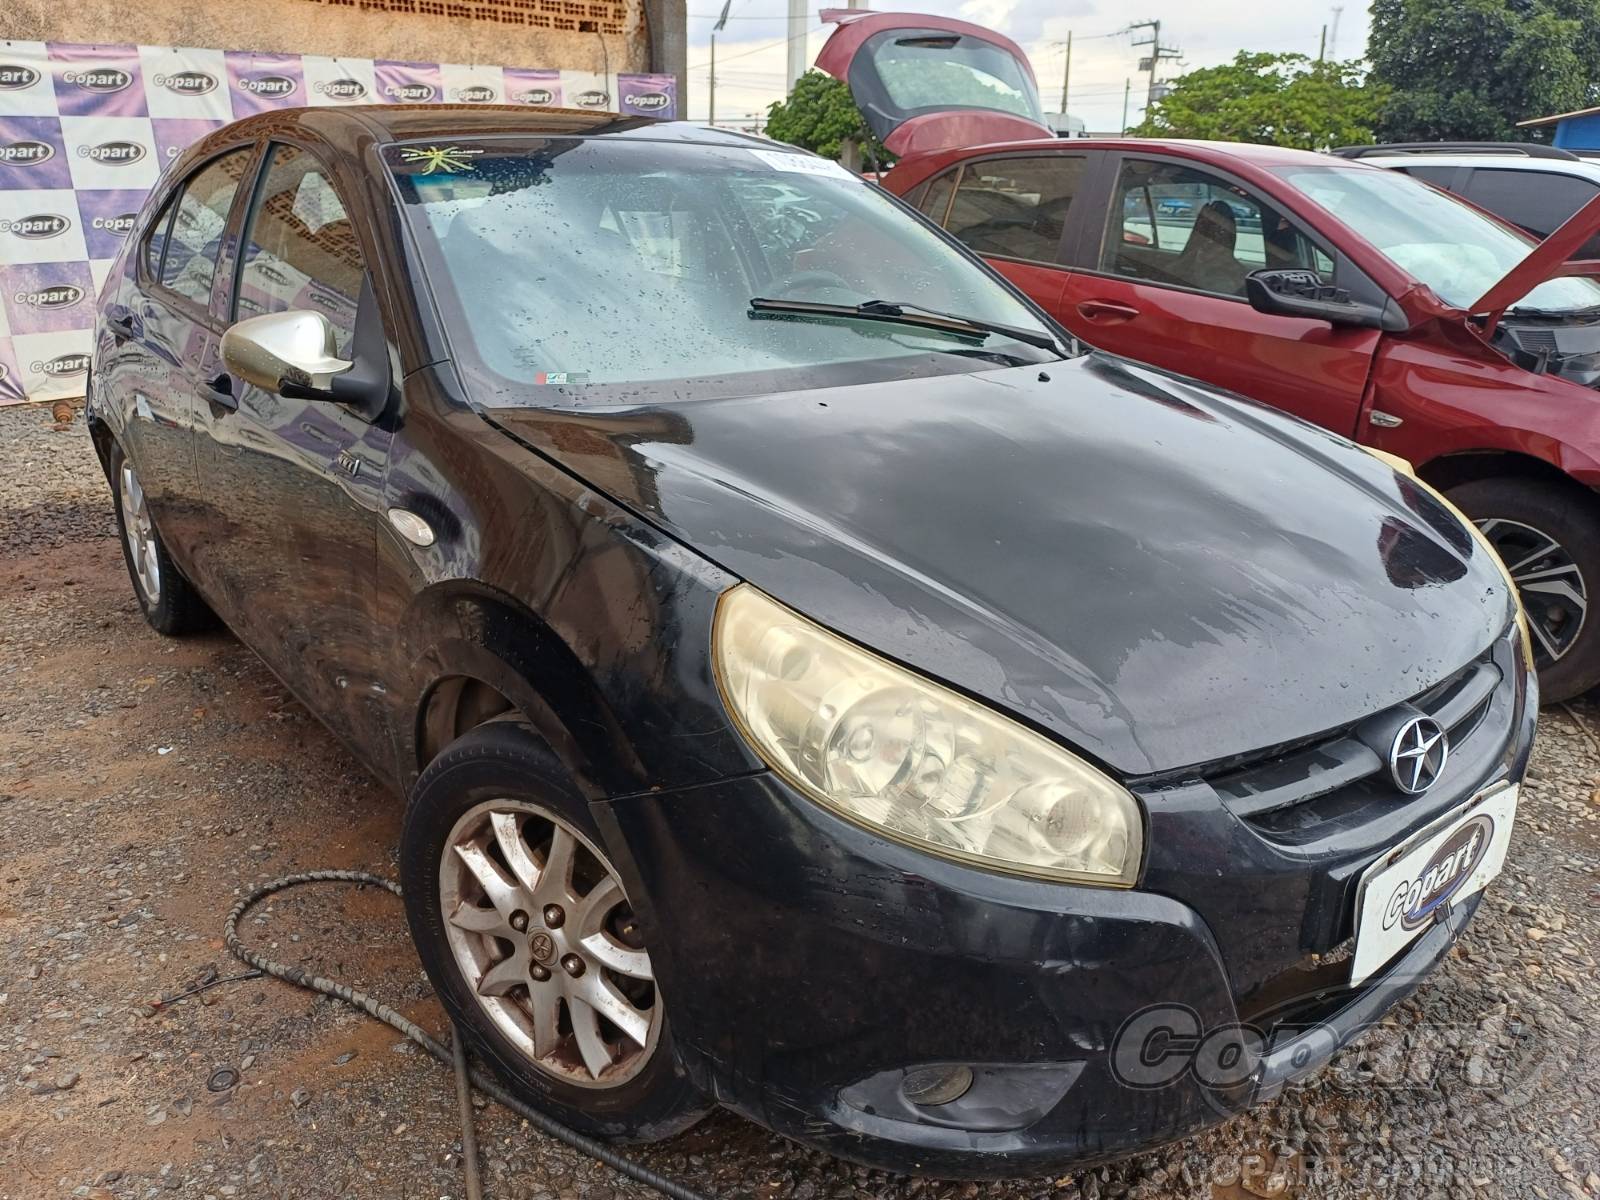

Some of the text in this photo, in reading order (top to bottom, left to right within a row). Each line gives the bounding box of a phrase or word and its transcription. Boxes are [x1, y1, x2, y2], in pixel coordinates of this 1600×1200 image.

[62, 70, 124, 87] Copart
[152, 73, 209, 91] Copart
[238, 78, 290, 94] Copart
[314, 81, 361, 97] Copart
[384, 85, 430, 99] Copart
[450, 87, 492, 102] Copart
[511, 90, 550, 104] Copart
[624, 94, 665, 107] Copart
[77, 144, 137, 160] Copart
[0, 221, 62, 234] Copart
[92, 217, 136, 234] Copa
[14, 289, 77, 305] Copart
[30, 357, 89, 374] Copart
[1382, 824, 1480, 931] Copart
